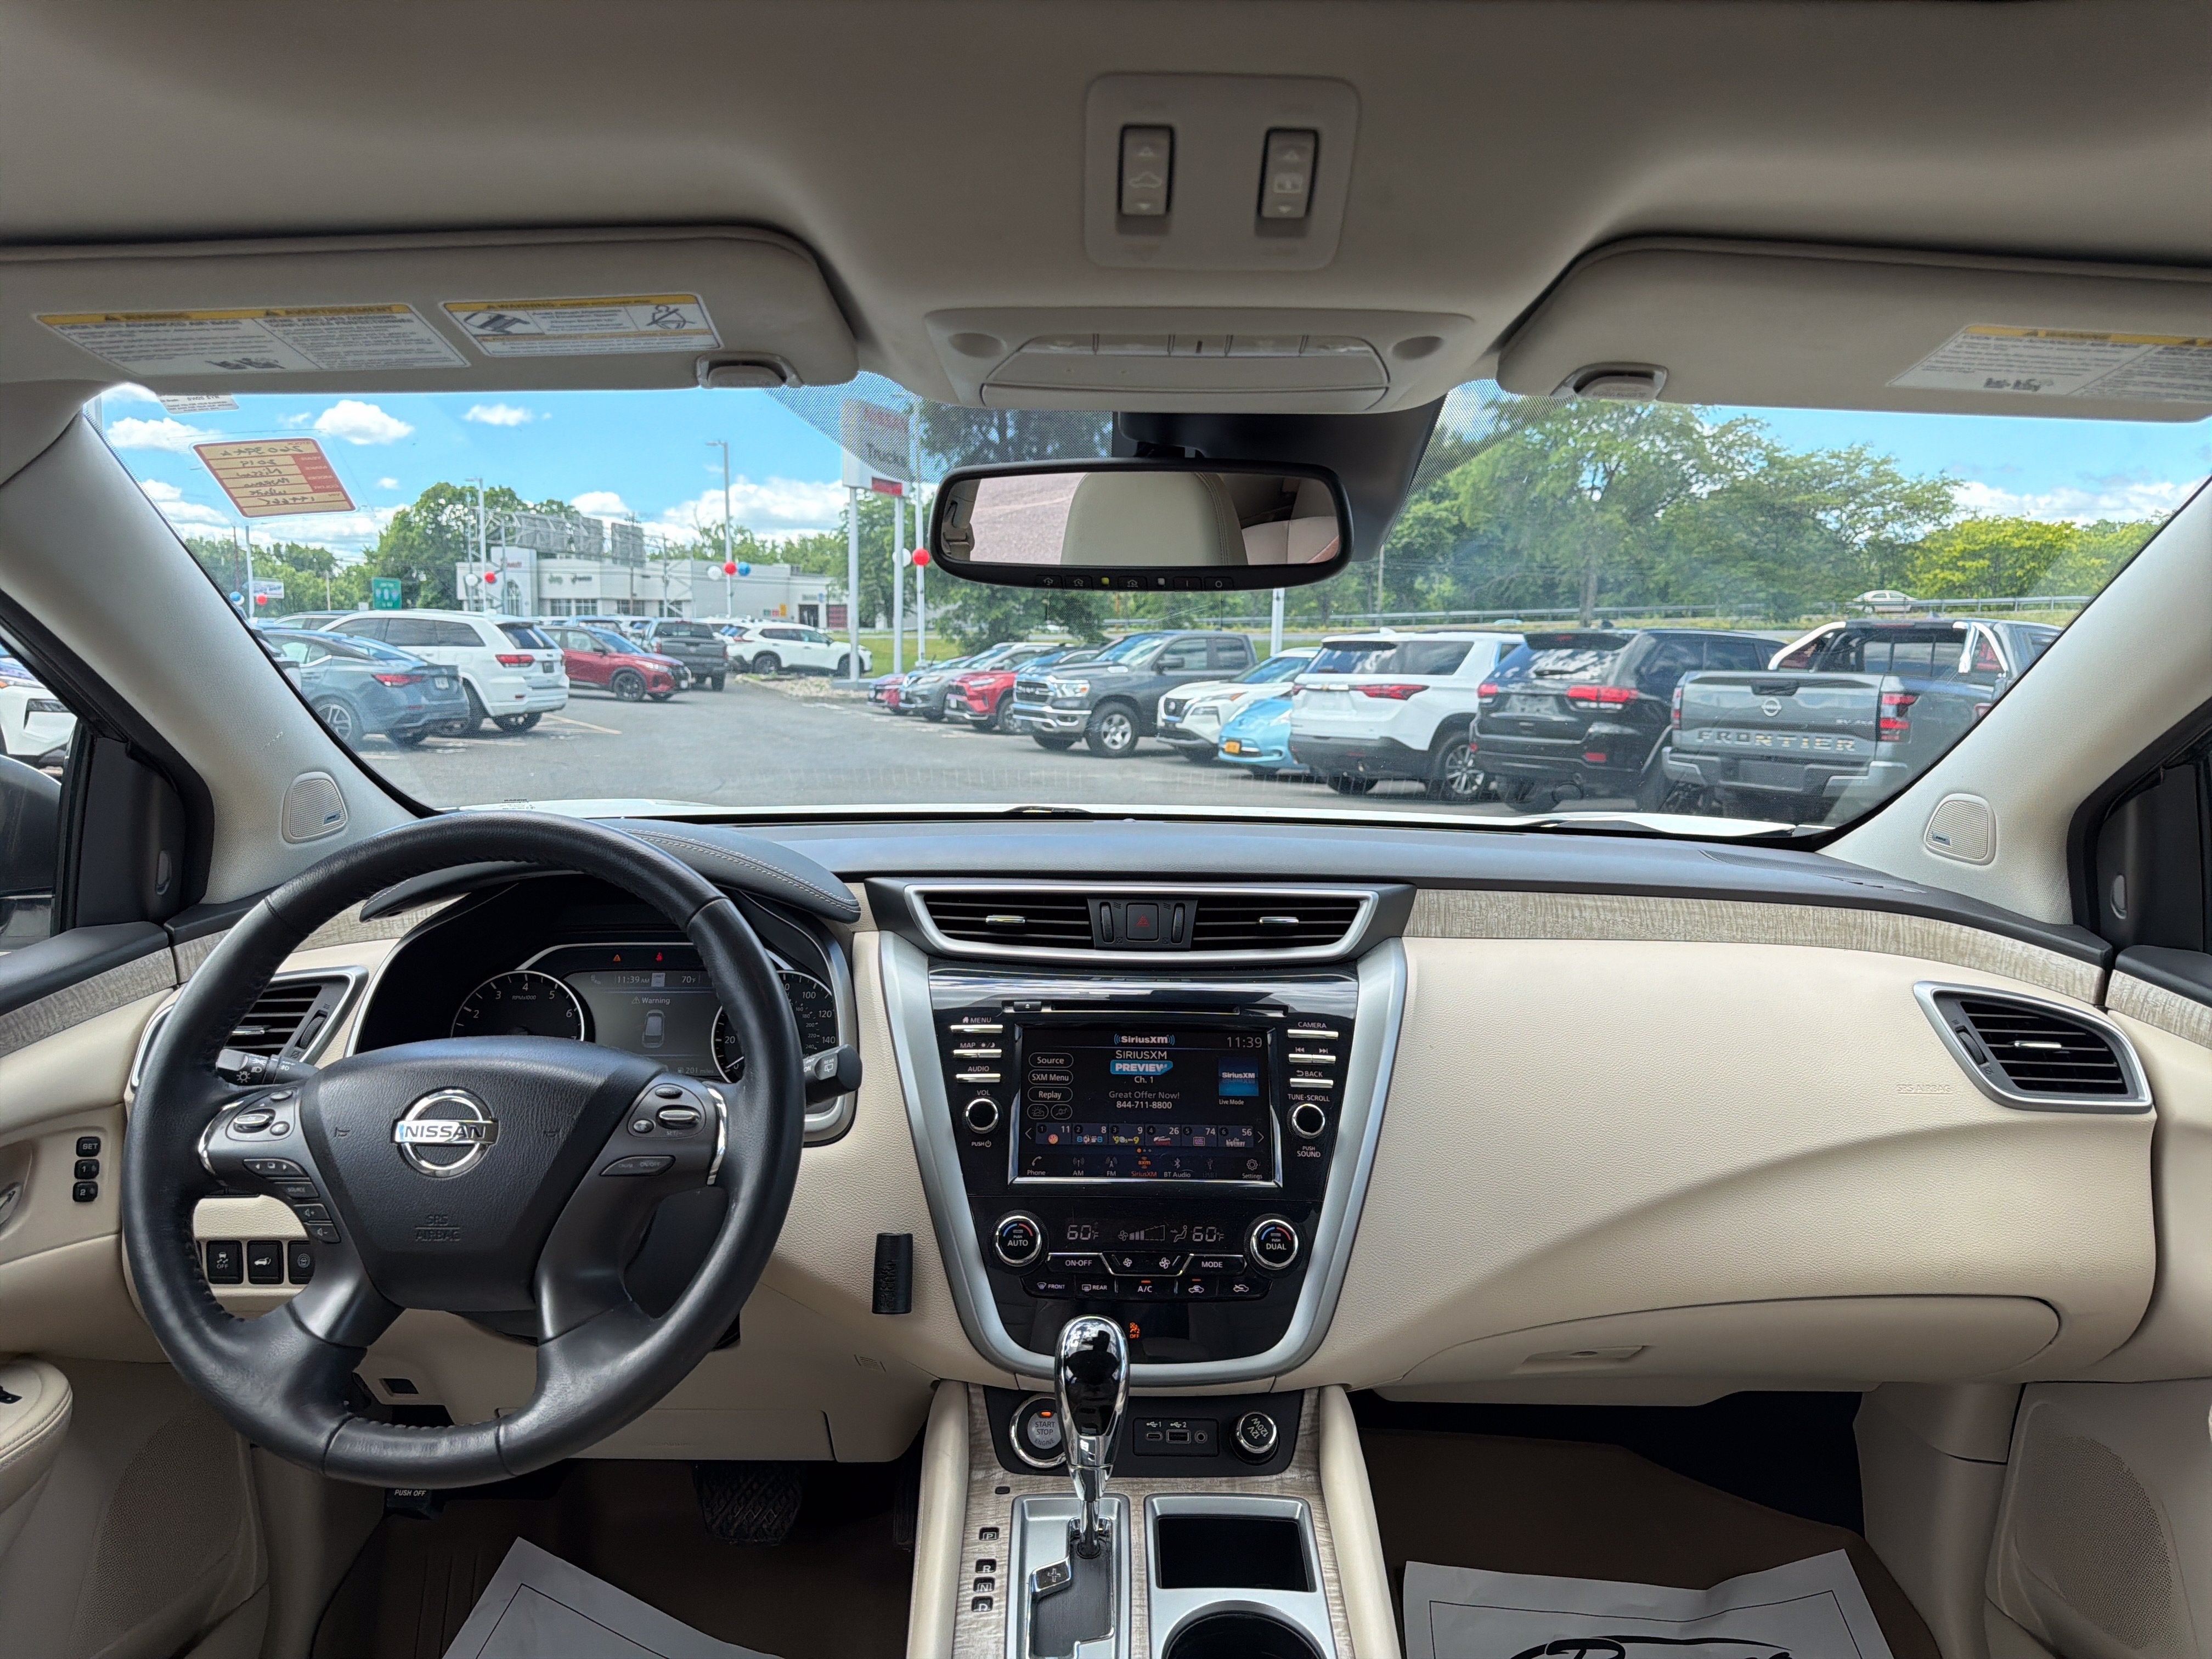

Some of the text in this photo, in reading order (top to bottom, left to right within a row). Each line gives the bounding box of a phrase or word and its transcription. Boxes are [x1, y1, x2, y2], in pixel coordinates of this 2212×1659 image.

[1696, 730, 1856, 752] FRONTIER
[617, 975, 640, 984] 11:39
[522, 983, 529, 991] 4
[495, 991, 501, 1000] 3
[549, 991, 555, 1000] 5
[473, 1010, 479, 1019] 2
[566, 1009, 573, 1018] 6
[1227, 1037, 1262, 1048] 11:39
[1115, 1051, 1167, 1059] SIRIUSXM
[1115, 1063, 1168, 1072] PREVIEW
[1039, 1091, 1062, 1099] Replay
[1109, 1091, 1132, 1099] Great
[1116, 1101, 1172, 1109] 844-711-8800
[405, 1125, 486, 1138] NISSAN
[1169, 1127, 1180, 1135] 26
[1205, 1127, 1216, 1136] 74
[1251, 1418, 1269, 1437] 120W
[1247, 1427, 1260, 1440] 12V
[1035, 1438, 1055, 1446] ENGINE
[983, 1565, 991, 1573] R
[979, 1603, 988, 1612] D
